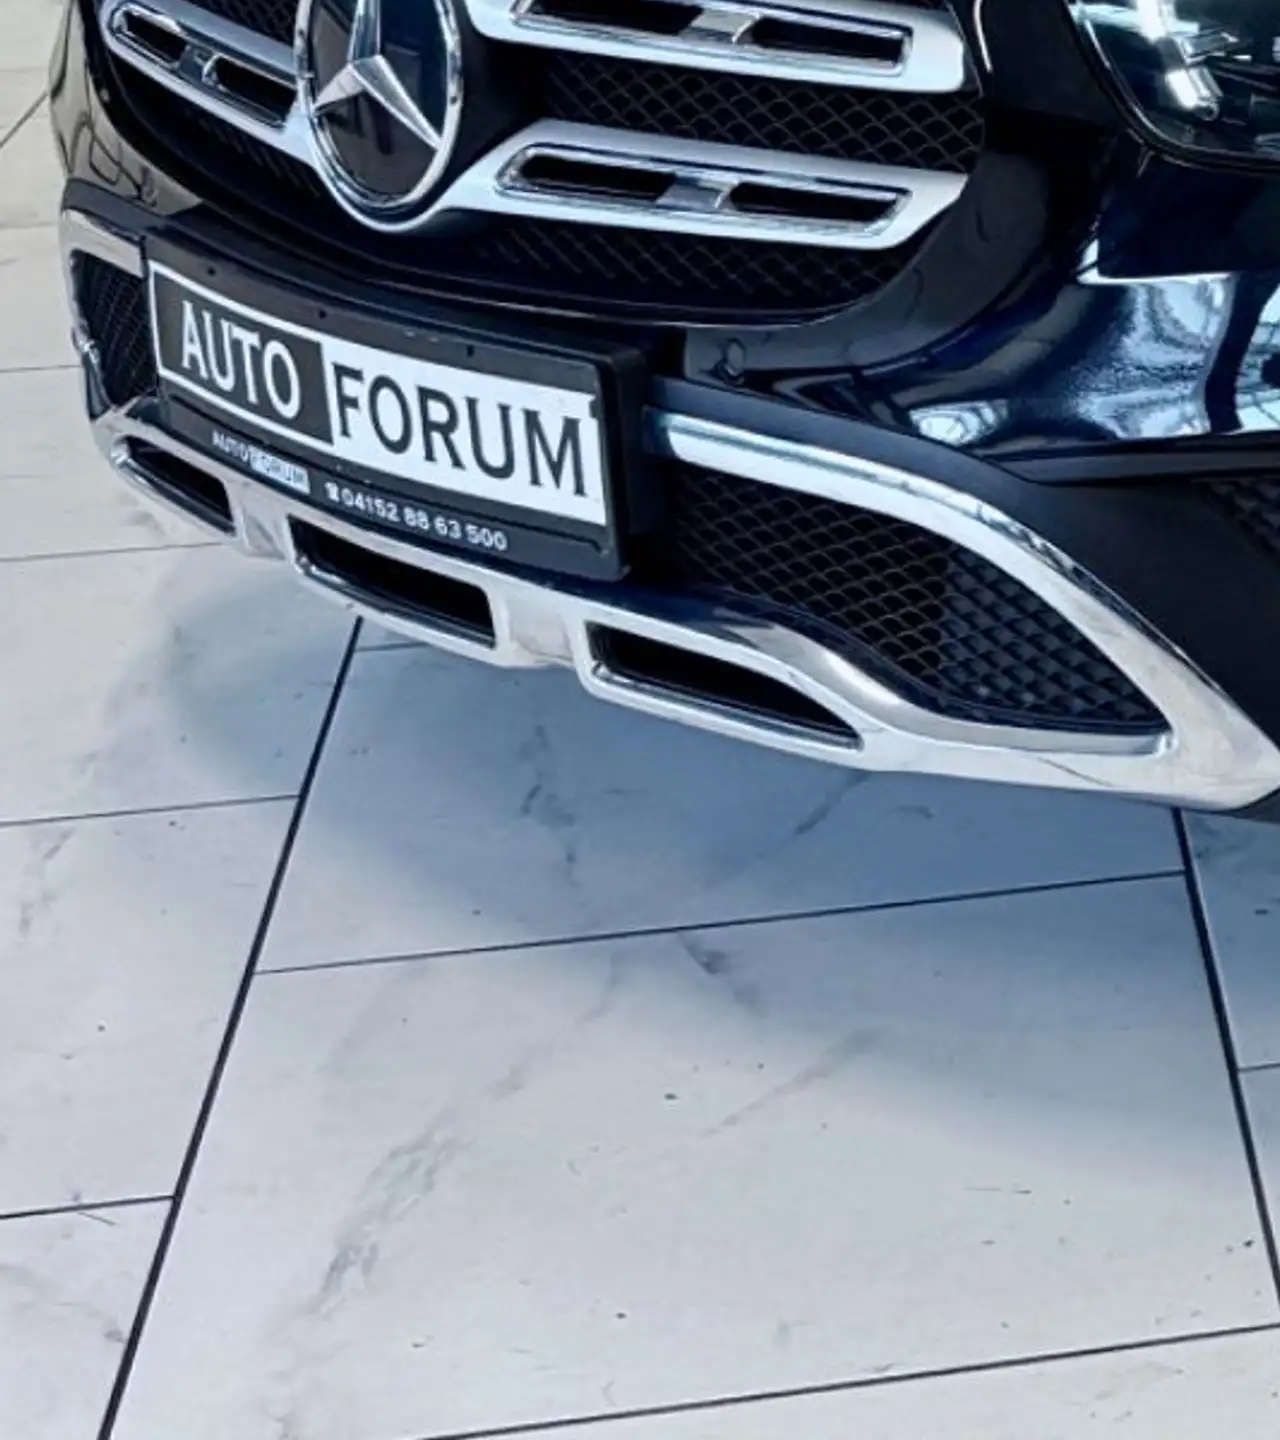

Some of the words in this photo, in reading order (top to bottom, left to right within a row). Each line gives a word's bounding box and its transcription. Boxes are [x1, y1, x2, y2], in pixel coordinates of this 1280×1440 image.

[181, 300, 301, 420] AUTO
[332, 362, 588, 498] FORUM
[341, 488, 400, 522] 04152
[403, 507, 429, 530] 88
[434, 516, 461, 540] 63
[465, 523, 507, 551] 500
